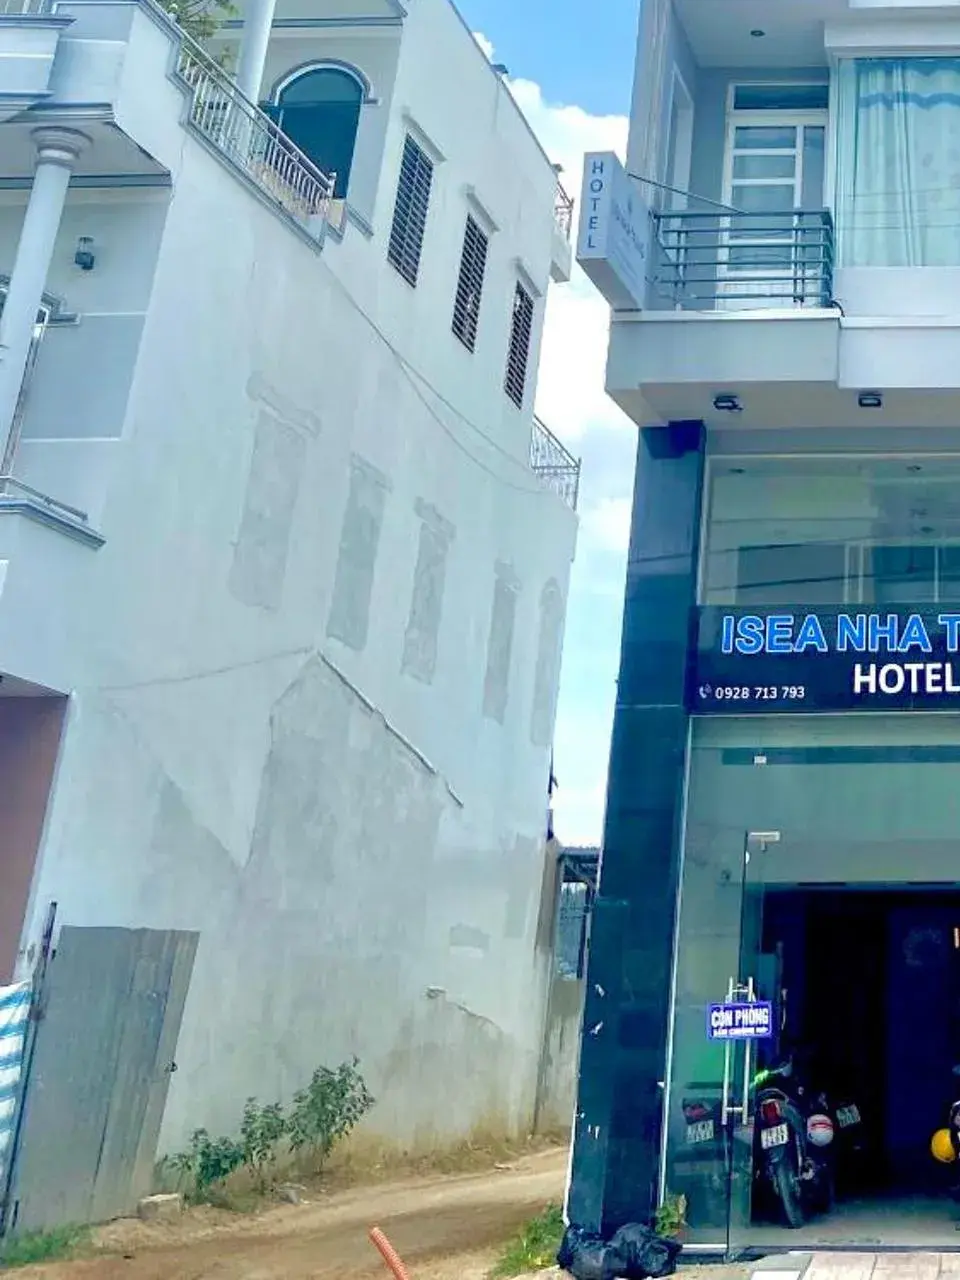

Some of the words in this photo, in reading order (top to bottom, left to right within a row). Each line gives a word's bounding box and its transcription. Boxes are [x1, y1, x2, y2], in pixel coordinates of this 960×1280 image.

[588, 161, 604, 249] HOTEL
[721, 615, 829, 654] ISEA
[836, 614, 932, 652] NHA
[715, 686, 750, 700] 0928
[754, 686, 778, 700] 713
[781, 685, 805, 699] 793
